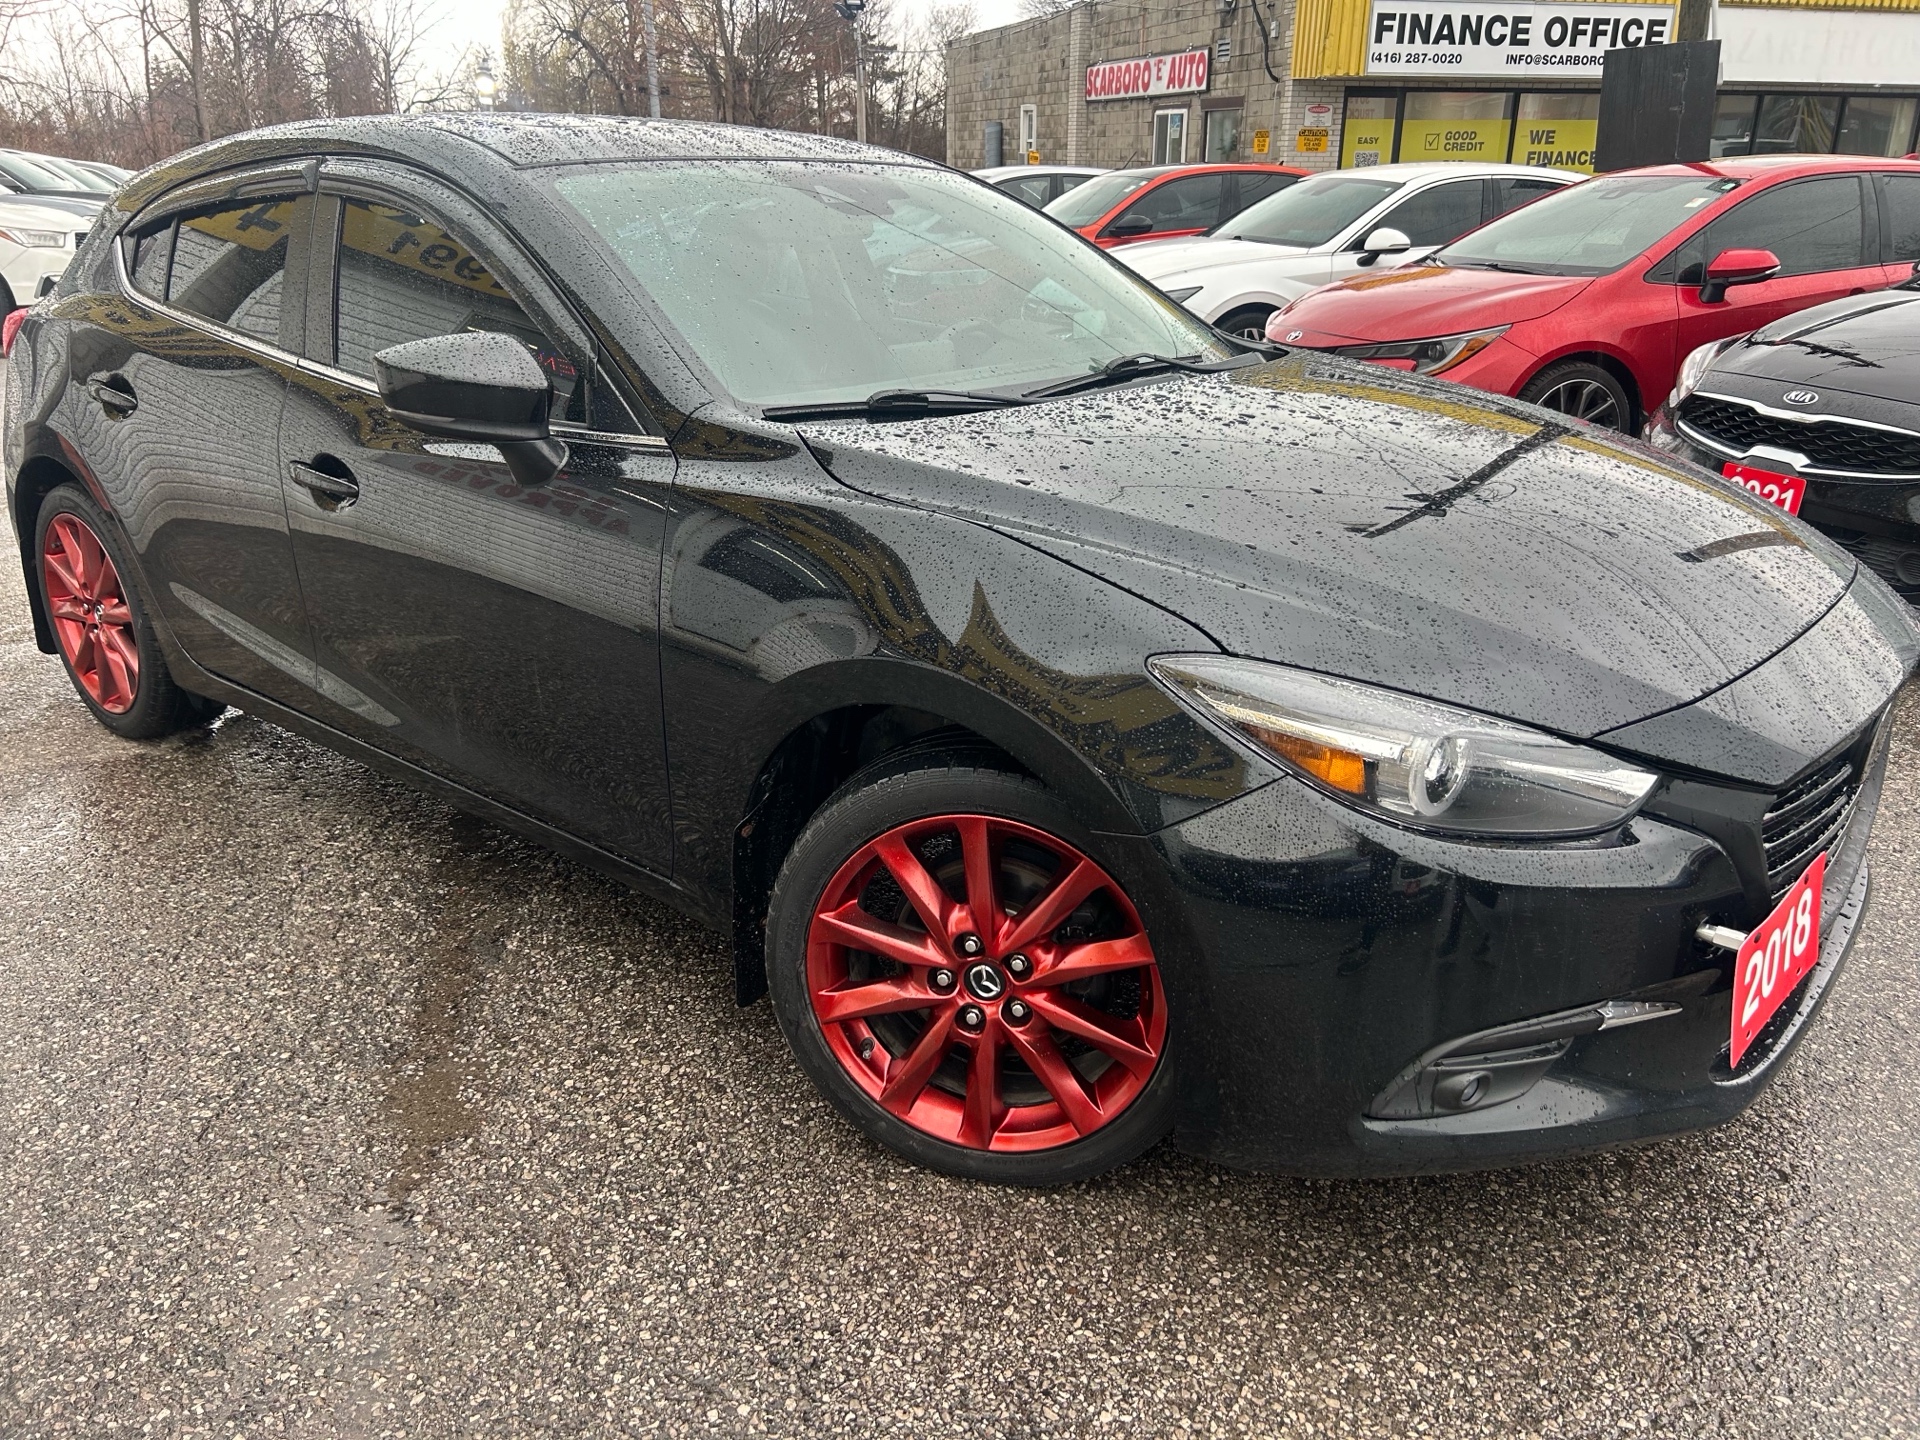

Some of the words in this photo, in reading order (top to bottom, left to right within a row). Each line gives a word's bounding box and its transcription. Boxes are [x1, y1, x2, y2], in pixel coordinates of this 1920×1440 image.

[1374, 12, 1532, 47] FINANCE
[1544, 16, 1667, 48] OFFICE
[1371, 52, 1401, 63] (416)
[1405, 53, 1463, 64] 287-0020
[1506, 54, 1604, 66] INFO@SCARBORO
[1087, 60, 1151, 98] SCARBORO
[1166, 52, 1206, 90] AUTO
[1445, 131, 1477, 141] GOOD
[1529, 130, 1556, 145] WE
[1443, 142, 1484, 151] CREDIT
[1526, 150, 1596, 166] FINANCE
[1787, 390, 1812, 402] KIA
[1741, 887, 1813, 1028] 2018
